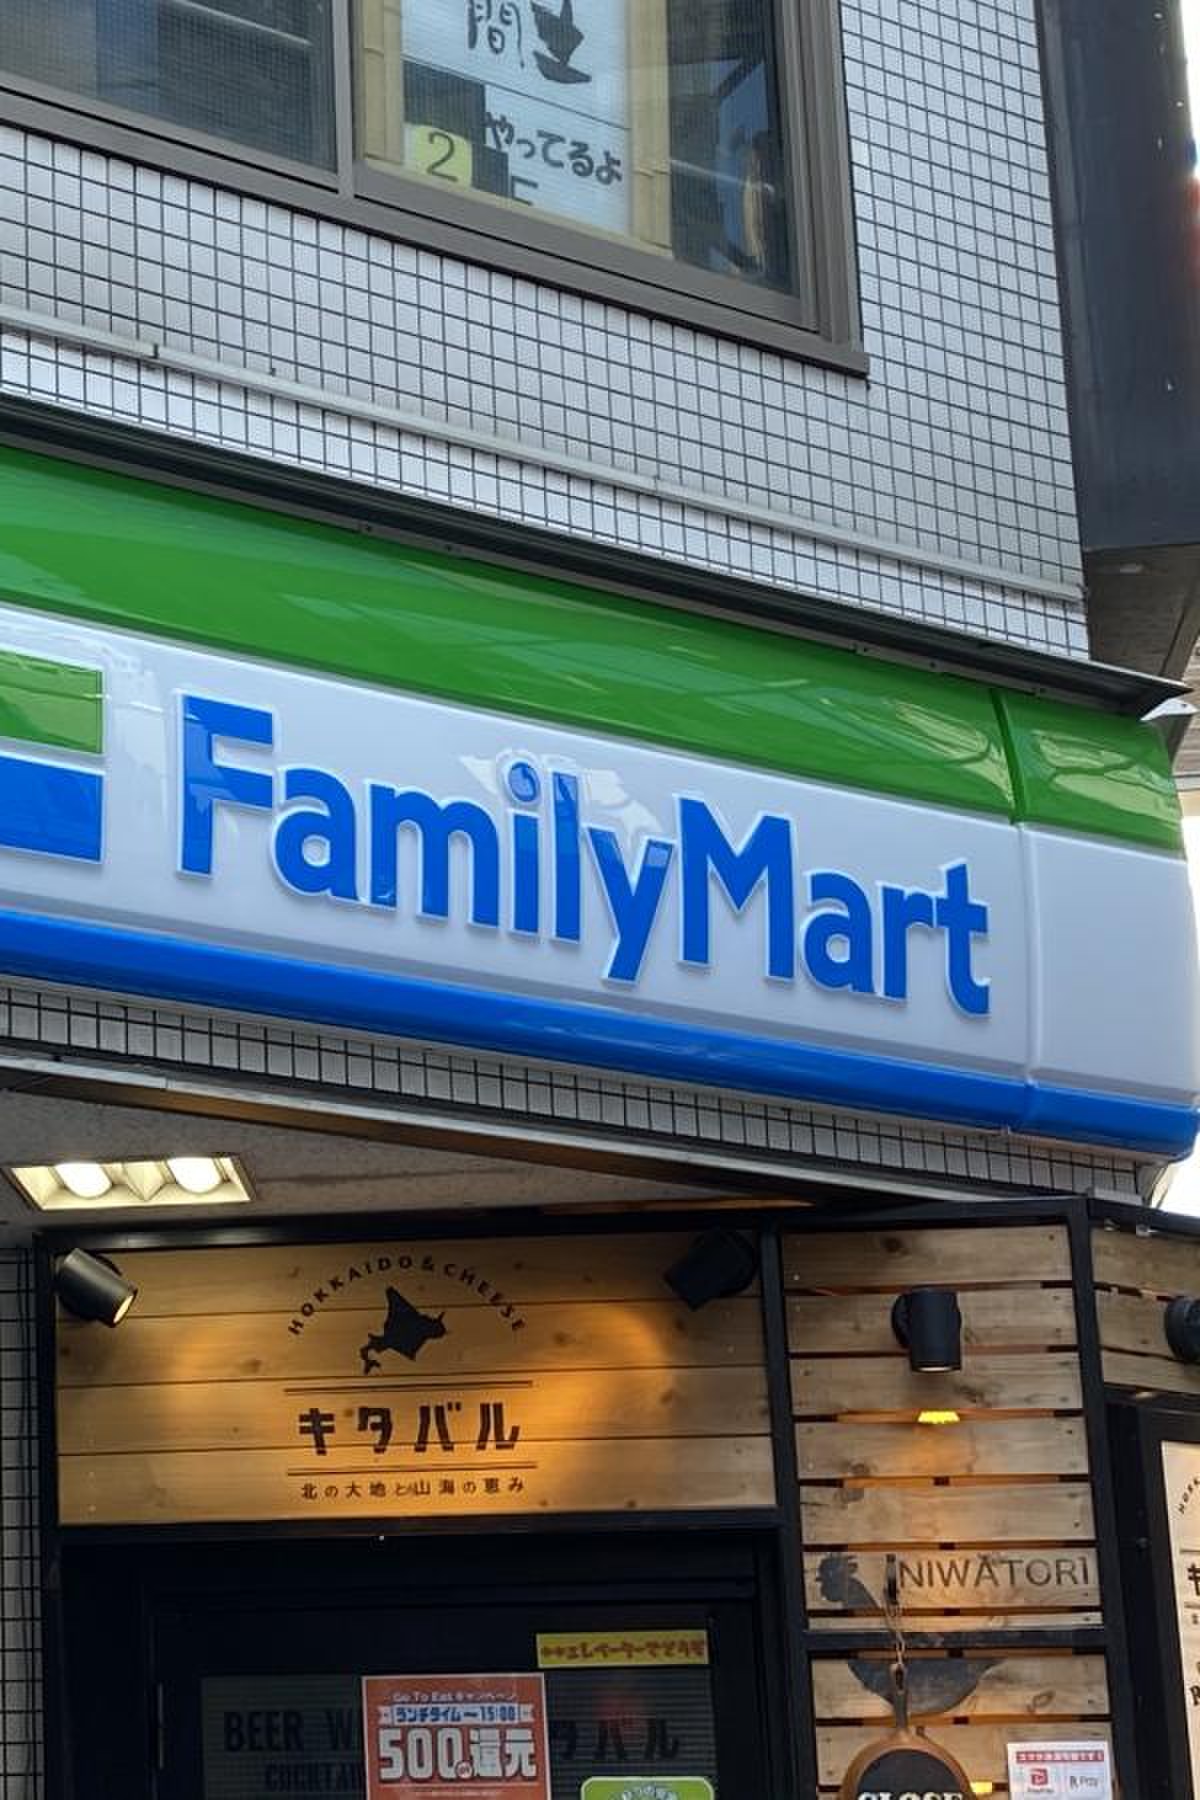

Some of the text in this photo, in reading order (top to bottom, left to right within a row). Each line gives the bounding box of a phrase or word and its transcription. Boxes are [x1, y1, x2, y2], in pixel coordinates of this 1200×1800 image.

[426, 132, 459, 182] 2
[482, 111, 623, 185] やってるよ
[178, 691, 992, 1016] FamilyMart
[298, 1401, 521, 1456] キタバル
[899, 1556, 1091, 1588] NIWATORI
[224, 1711, 304, 1751] BEER
